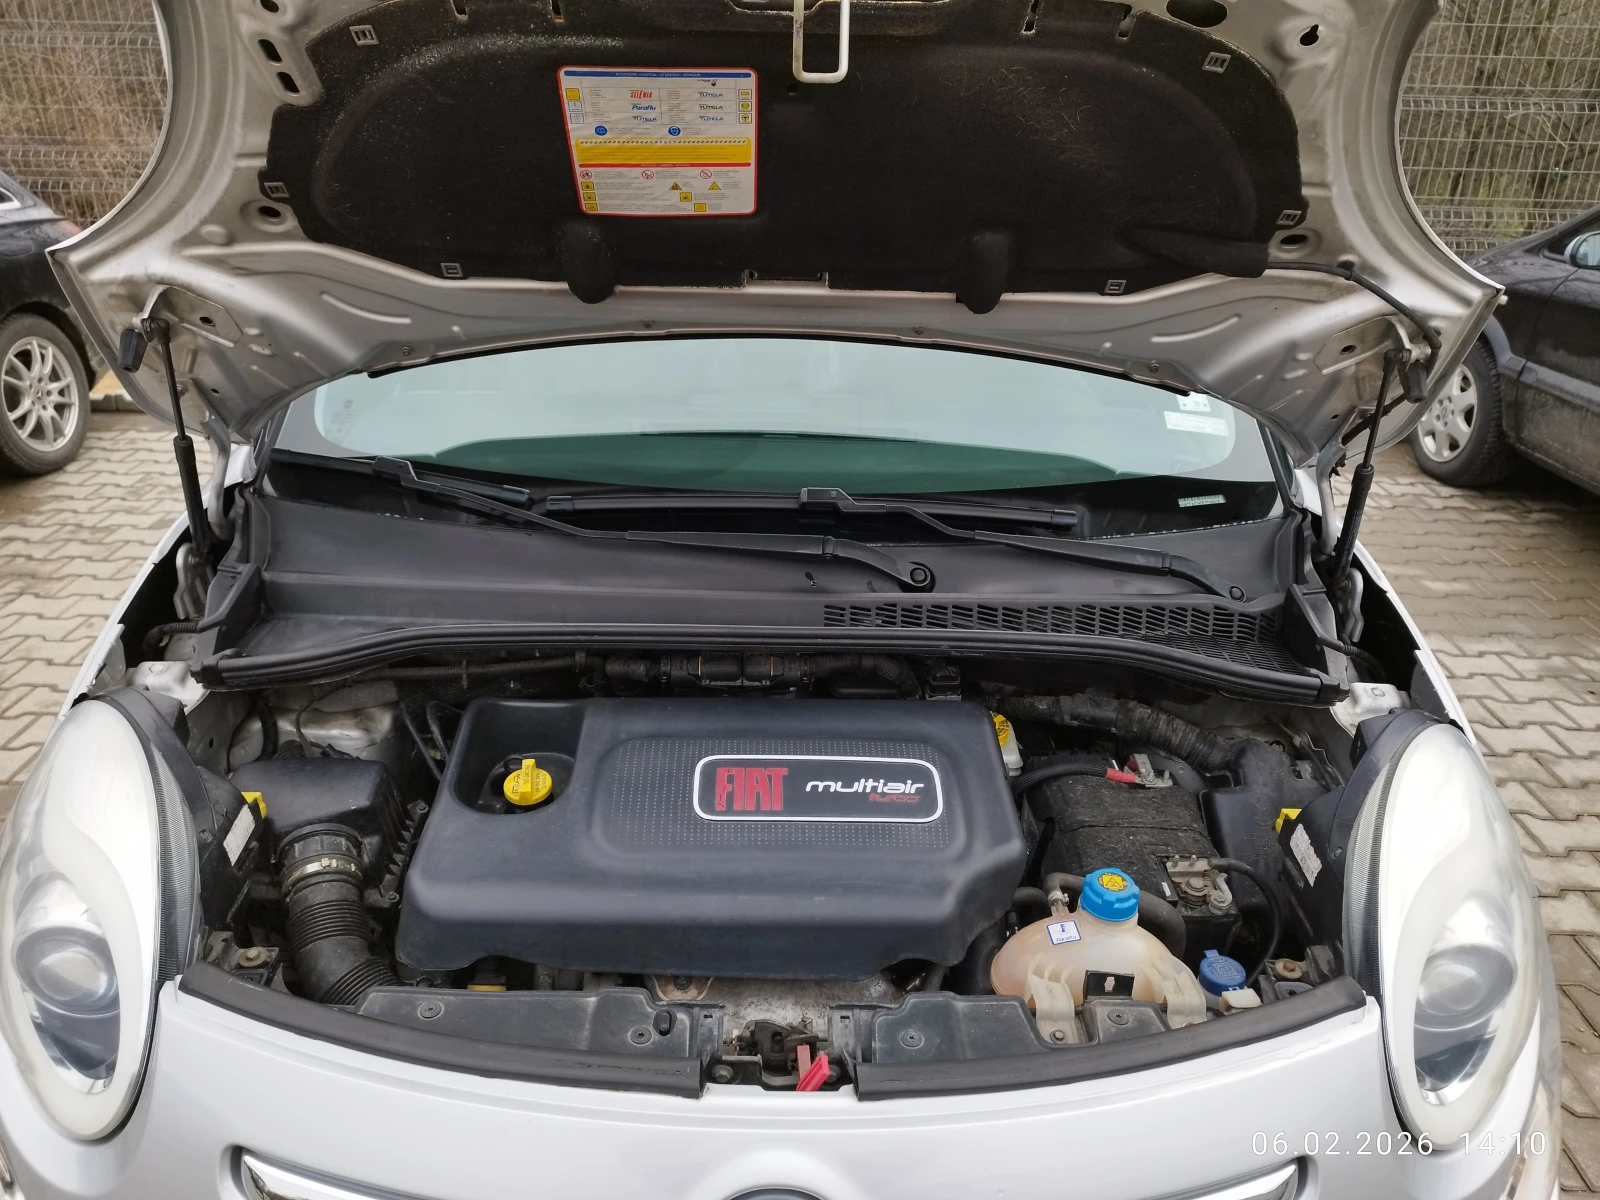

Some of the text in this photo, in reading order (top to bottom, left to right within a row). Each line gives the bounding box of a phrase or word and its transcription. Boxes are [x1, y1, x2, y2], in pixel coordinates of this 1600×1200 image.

[715, 767, 924, 811] FIAT multiair
[869, 793, 920, 803] turbo
